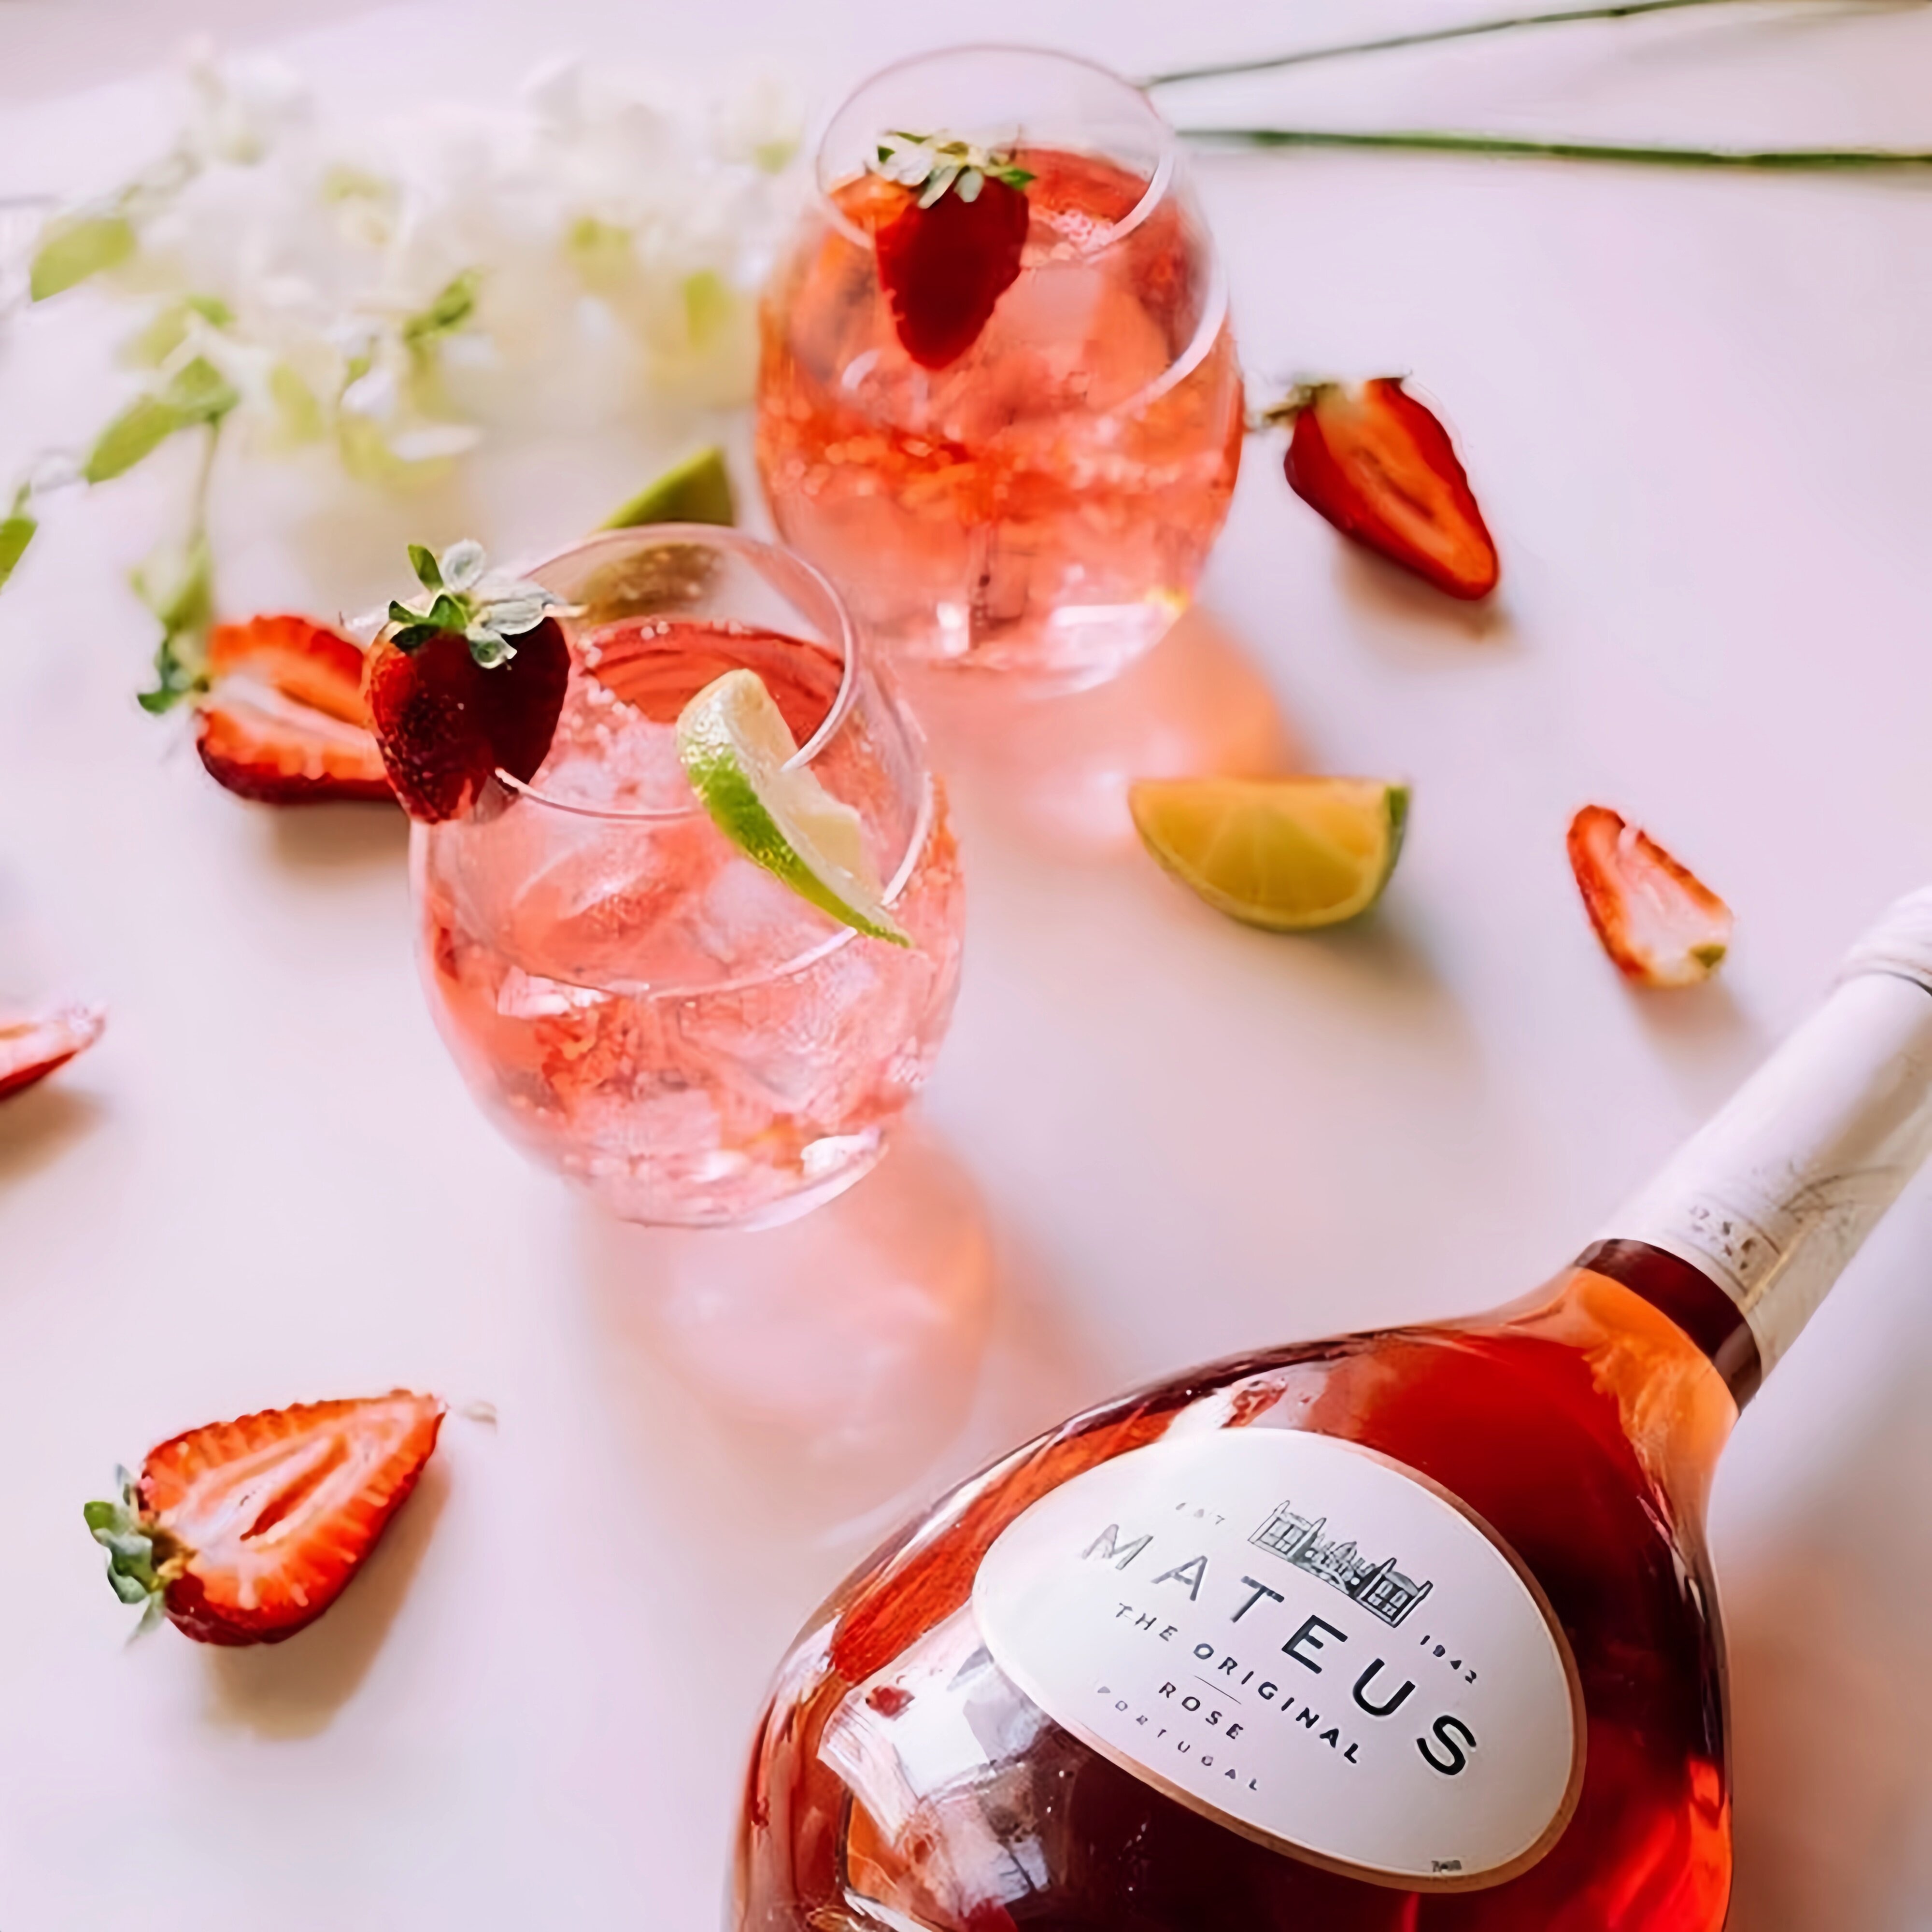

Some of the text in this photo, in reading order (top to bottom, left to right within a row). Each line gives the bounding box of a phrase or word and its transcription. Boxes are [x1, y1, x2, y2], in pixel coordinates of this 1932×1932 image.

[1081, 1524, 1477, 1776] MATEUS
[1115, 1602, 1359, 1764] THE ORIGINAL
